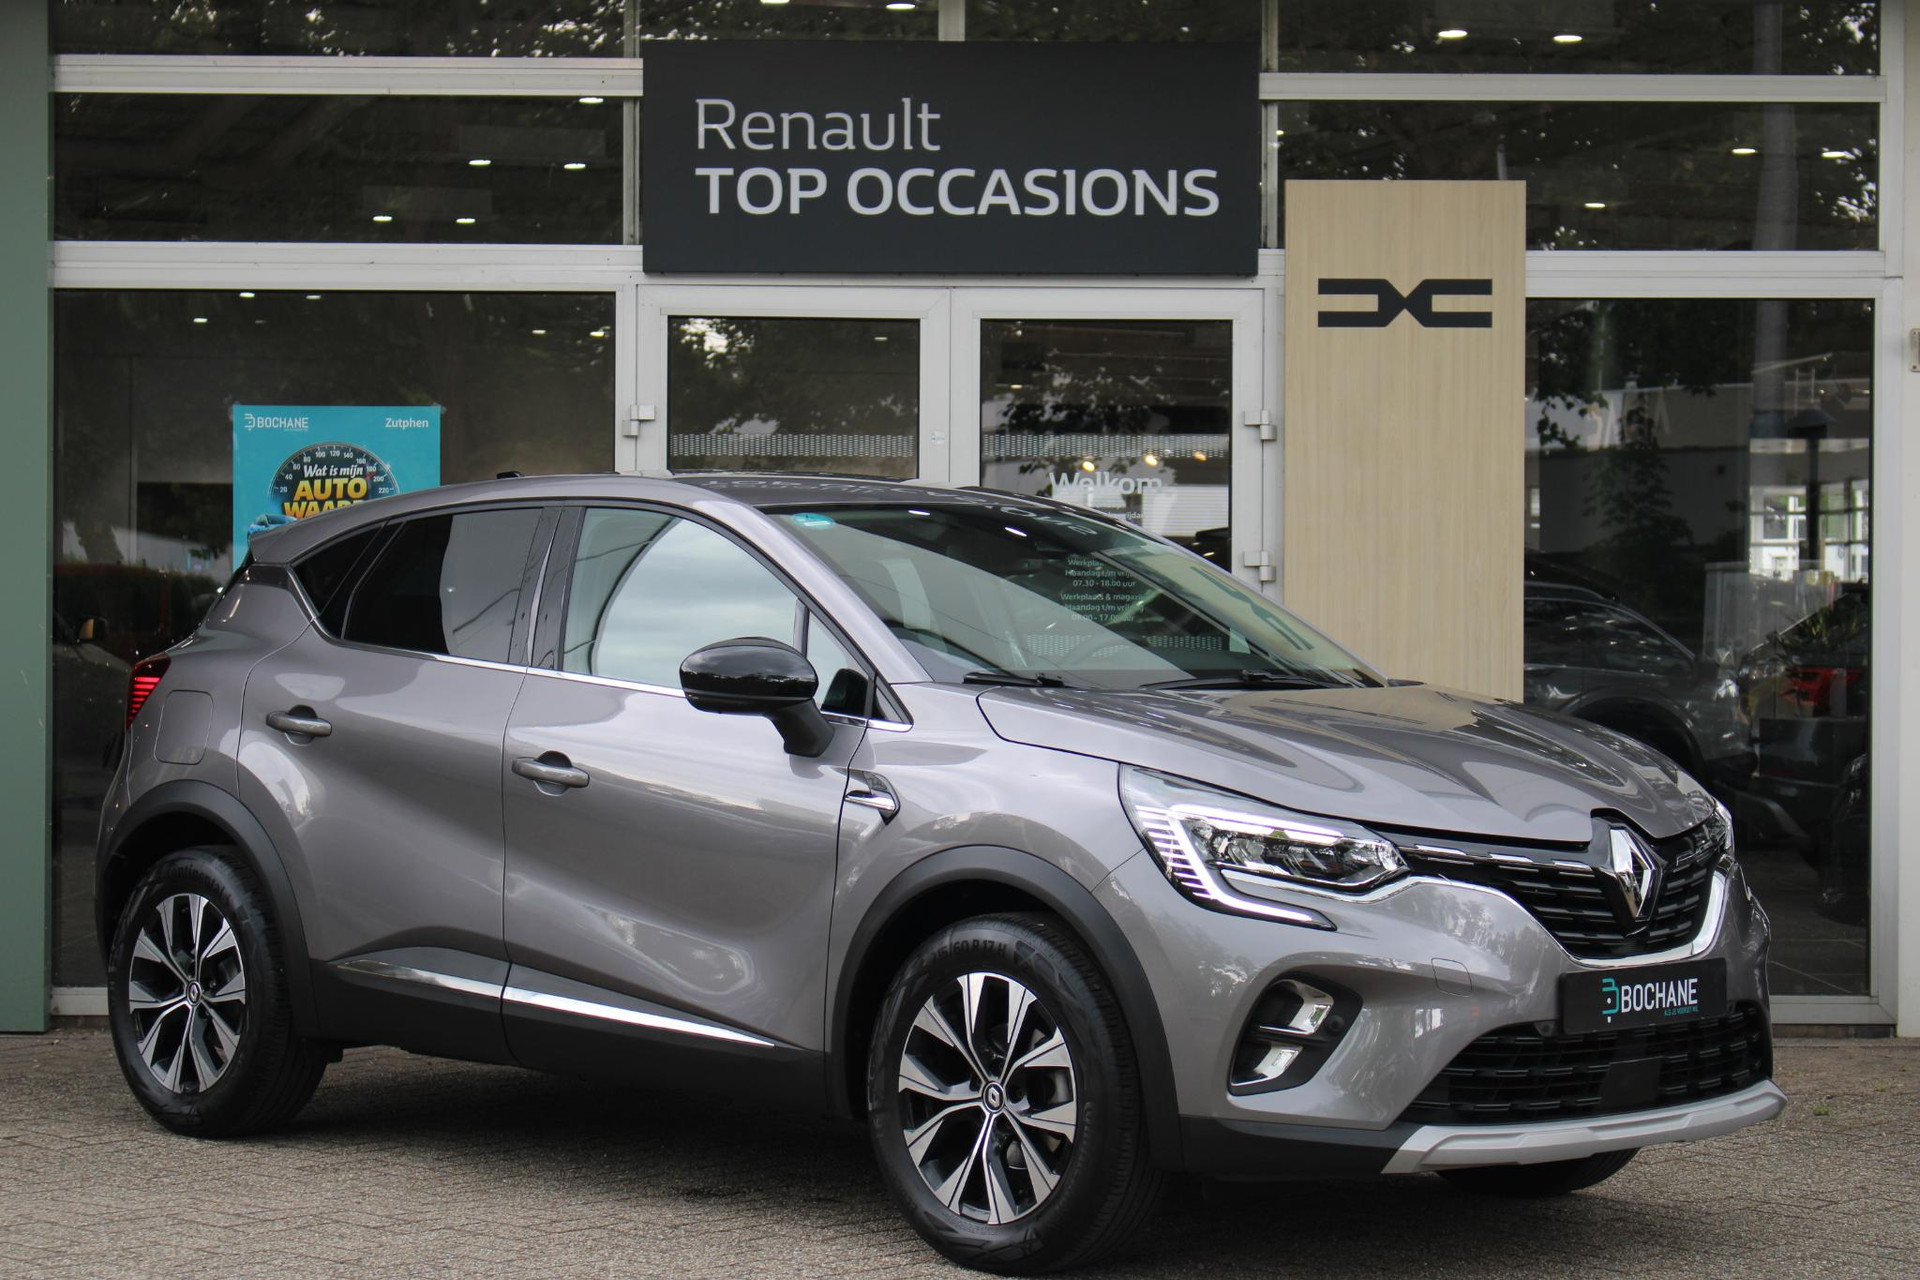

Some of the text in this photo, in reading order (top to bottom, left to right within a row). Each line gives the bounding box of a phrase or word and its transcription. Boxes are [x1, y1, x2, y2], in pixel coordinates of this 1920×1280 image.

[695, 97, 942, 151] Renault
[695, 167, 1220, 217] TOP OCCASIONS
[257, 416, 309, 429] BOCHANE
[385, 417, 429, 430] Zutphen
[285, 473, 293, 481] 40
[303, 464, 364, 478] Wat is mijn
[373, 475, 384, 483] 200
[293, 478, 368, 501] AUTO
[1049, 471, 1162, 495] Welkom
[284, 500, 363, 521] WAA
[1621, 978, 1698, 1013] BOCHANE
